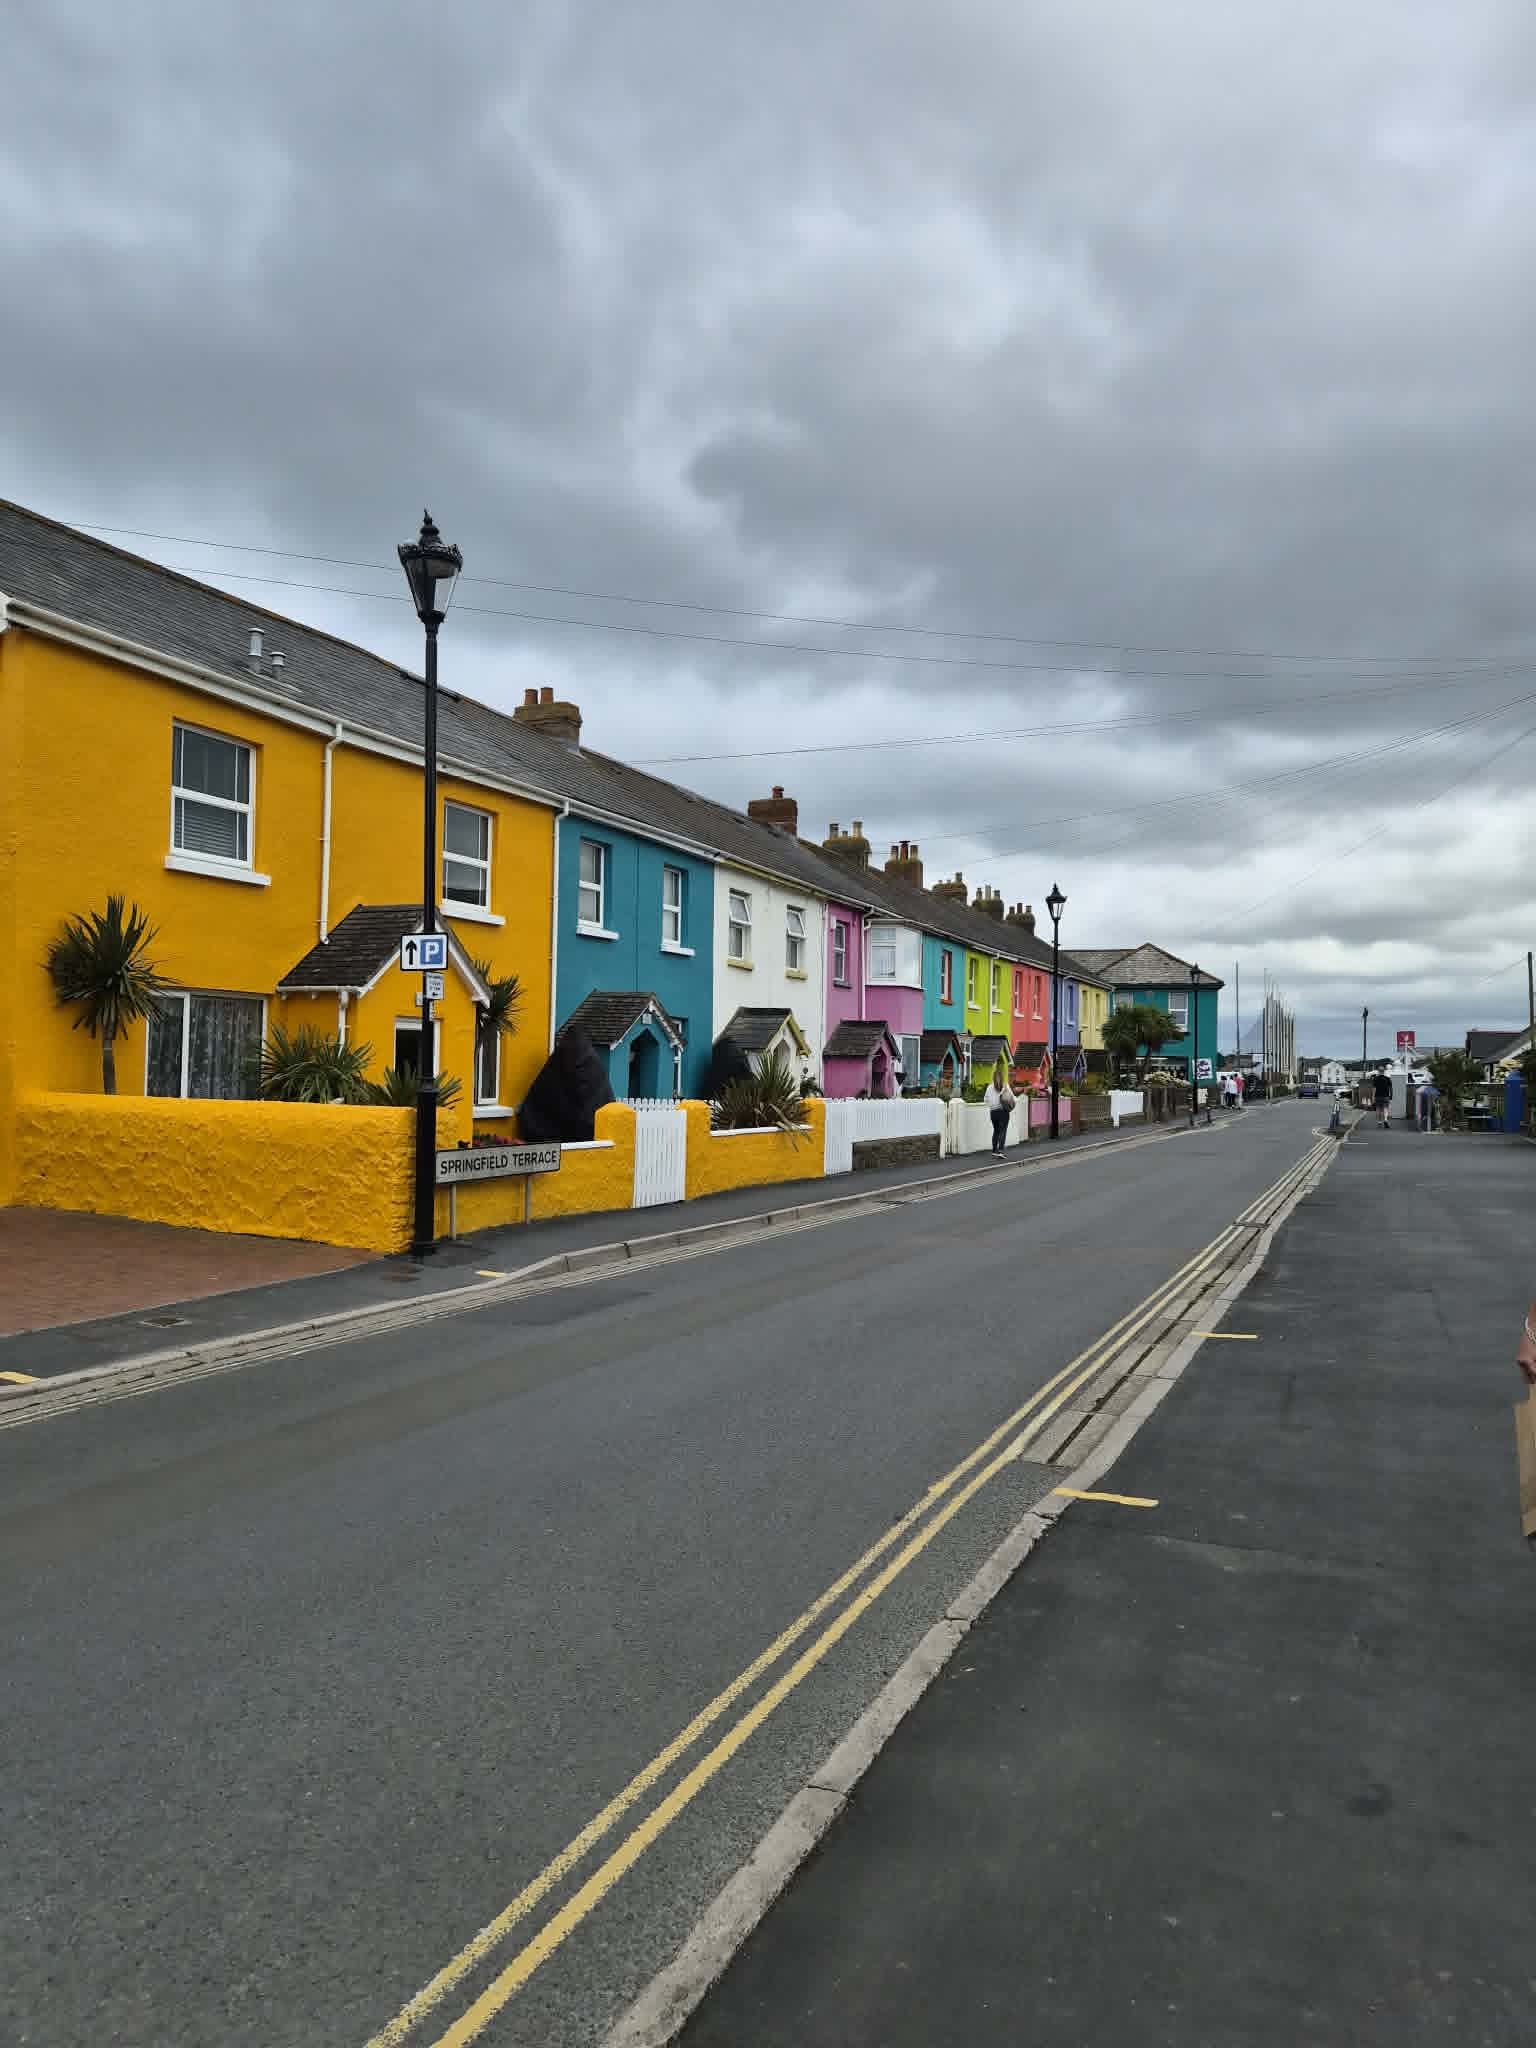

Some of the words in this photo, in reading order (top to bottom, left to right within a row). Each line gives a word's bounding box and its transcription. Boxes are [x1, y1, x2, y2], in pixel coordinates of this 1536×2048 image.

[425, 942, 440, 962] P
[440, 1155, 508, 1175] SPRINGFIELD
[512, 1150, 557, 1167] TERRACE
